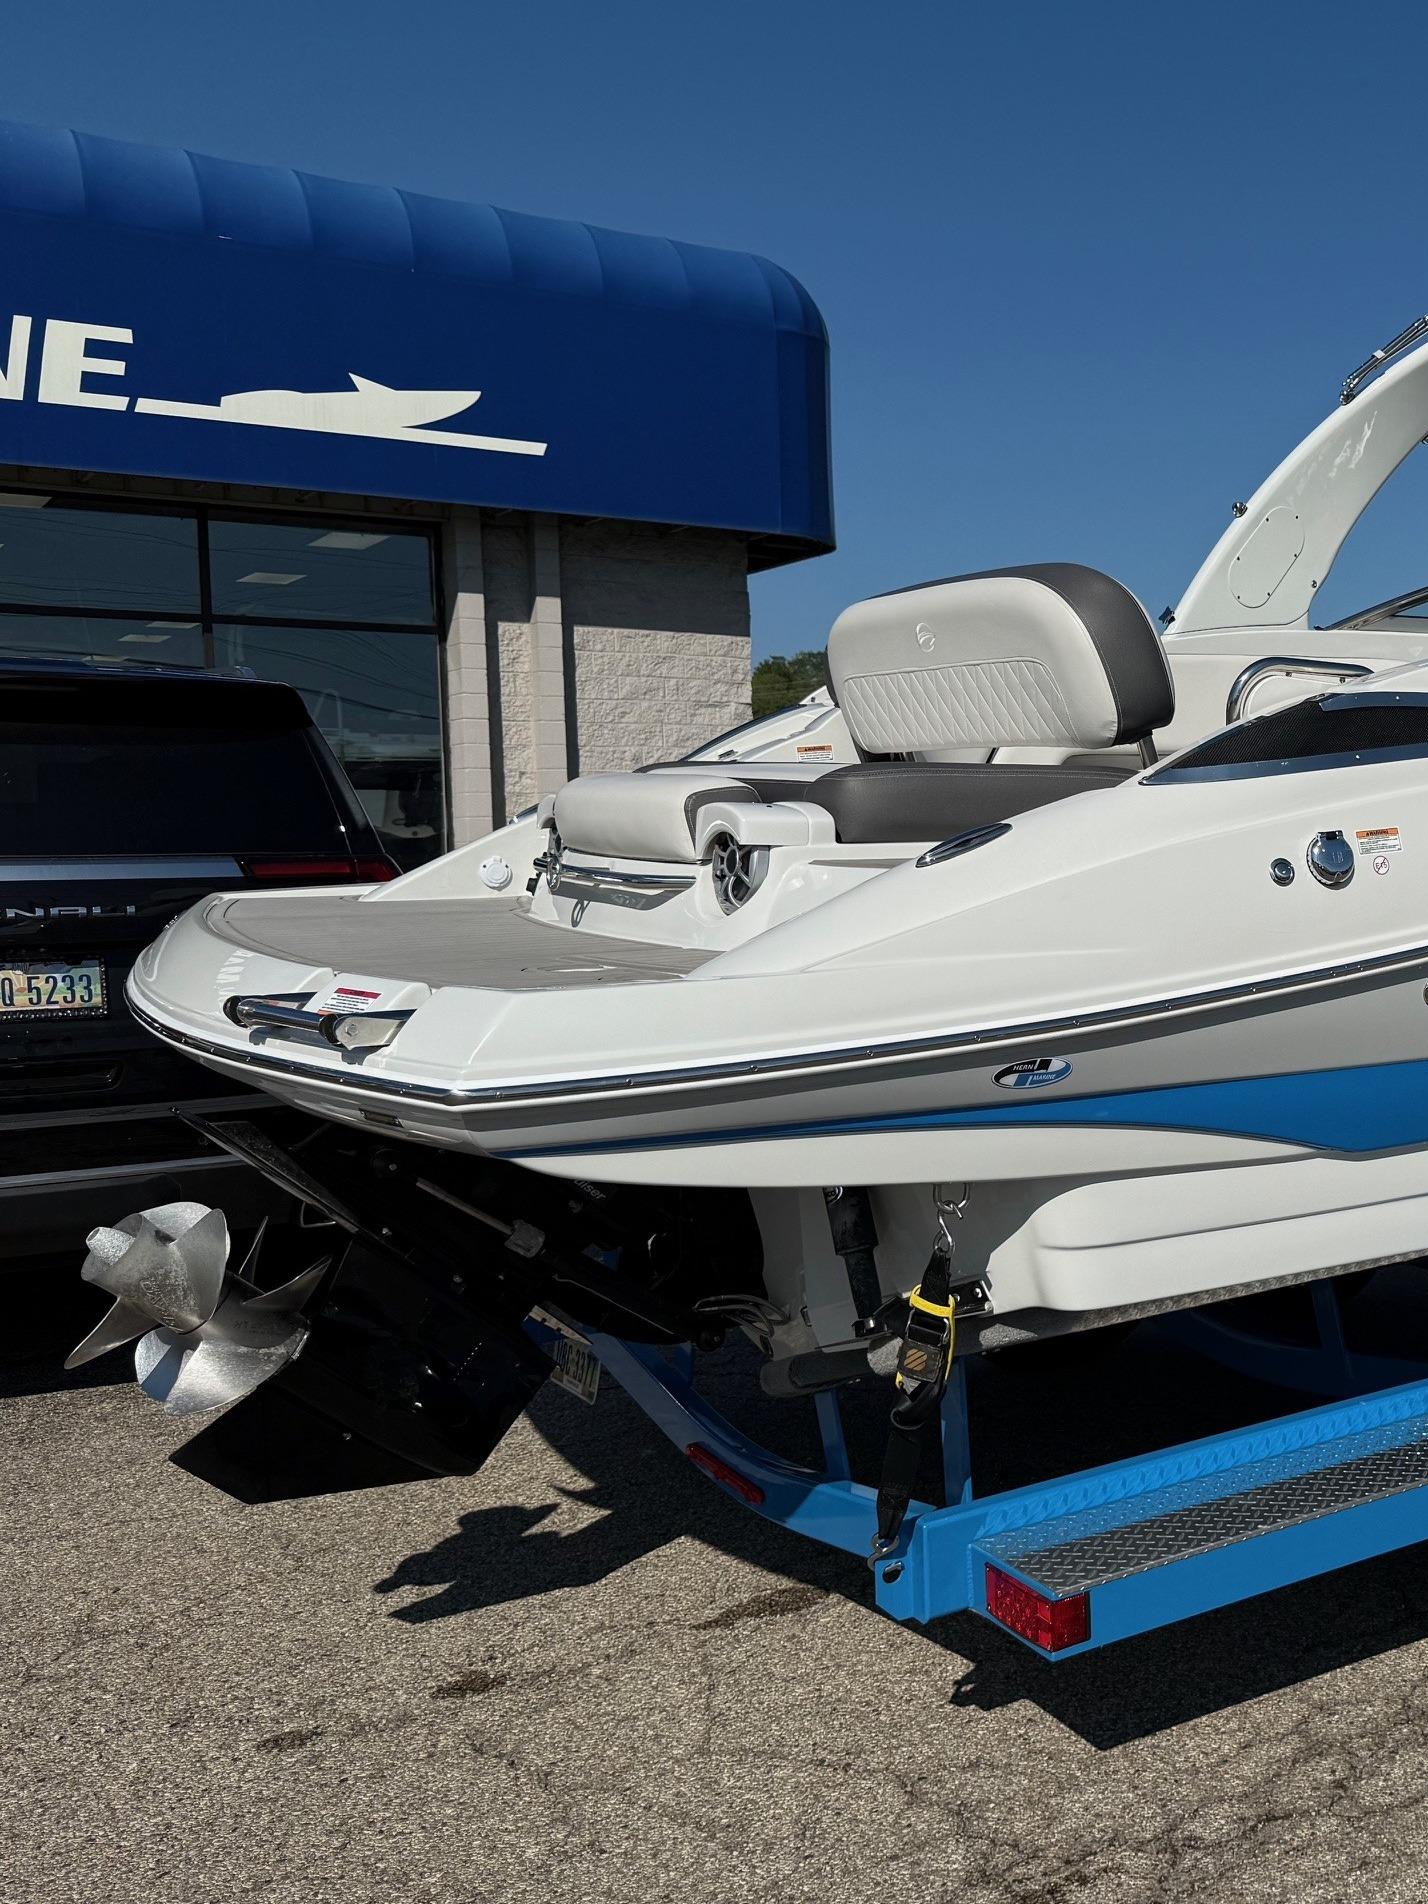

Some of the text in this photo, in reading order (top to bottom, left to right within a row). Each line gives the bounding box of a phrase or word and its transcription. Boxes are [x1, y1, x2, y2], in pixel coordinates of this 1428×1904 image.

[26, 973, 94, 1006] 5233
[1012, 1063, 1035, 1071] HERN
[1032, 1073, 1056, 1081] MARINE
